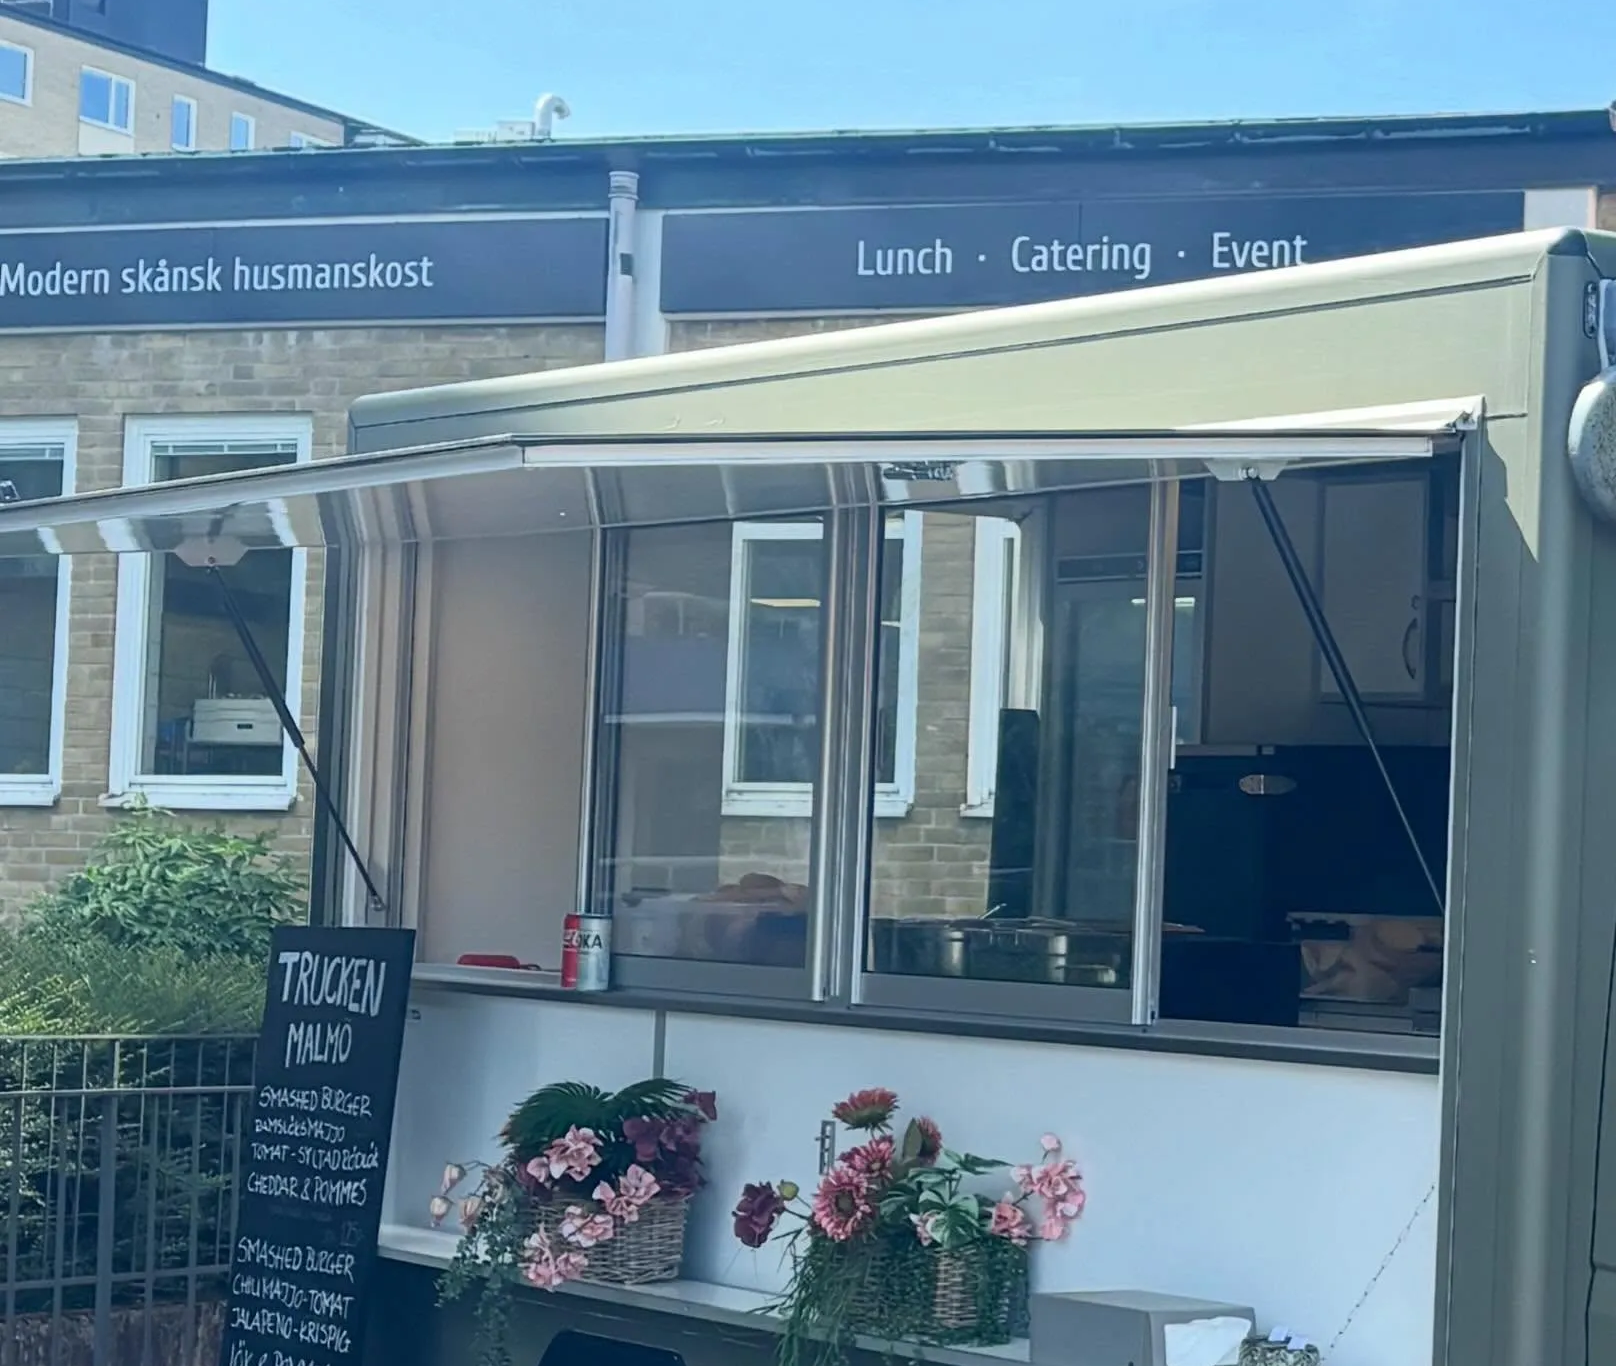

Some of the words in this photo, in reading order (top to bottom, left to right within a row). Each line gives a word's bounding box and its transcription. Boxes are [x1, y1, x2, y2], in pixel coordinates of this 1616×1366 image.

[0, 261, 109, 296] Modern
[121, 257, 222, 293] skånsk
[234, 253, 434, 291] husmanskost
[857, 238, 953, 276] Lunch
[1010, 235, 1152, 279] Catering
[1212, 231, 1307, 269] Event
[278, 951, 386, 1017] TRUCKEN
[285, 1017, 353, 1068] MALMÖ
[258, 1085, 318, 1112] SMASHED
[321, 1085, 373, 1117] BURGER
[247, 1172, 299, 1198] CHEDDAR
[300, 1177, 311, 1201] &
[313, 1175, 367, 1207] POMMES
[237, 1236, 302, 1271] SMASHED
[305, 1245, 355, 1284] BURGER
